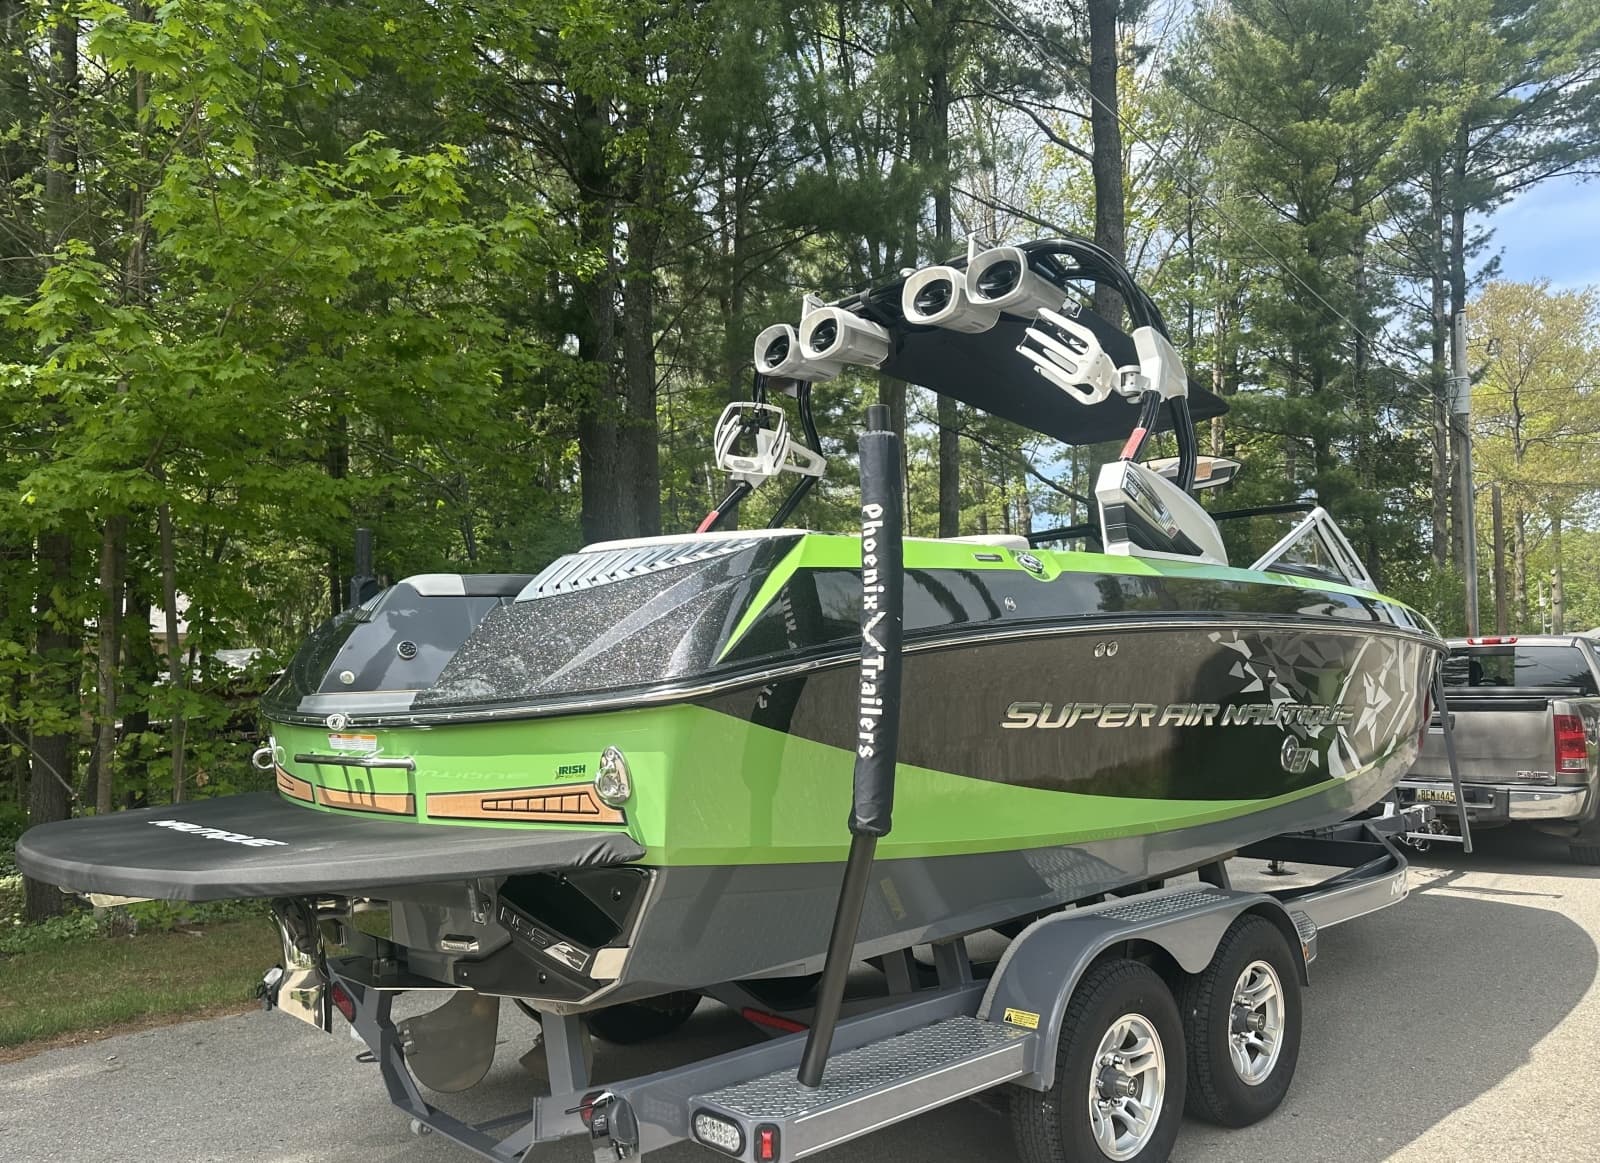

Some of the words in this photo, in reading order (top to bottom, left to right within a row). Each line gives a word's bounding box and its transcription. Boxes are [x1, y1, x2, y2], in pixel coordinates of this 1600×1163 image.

[863, 503, 885, 610] Phoenix
[859, 655, 884, 759] Trailers
[1001, 702, 1156, 729] SUPER
[1158, 703, 1219, 728] AIR
[1220, 703, 1355, 729] NAUTIQUE
[558, 764, 586, 775] IRISH
